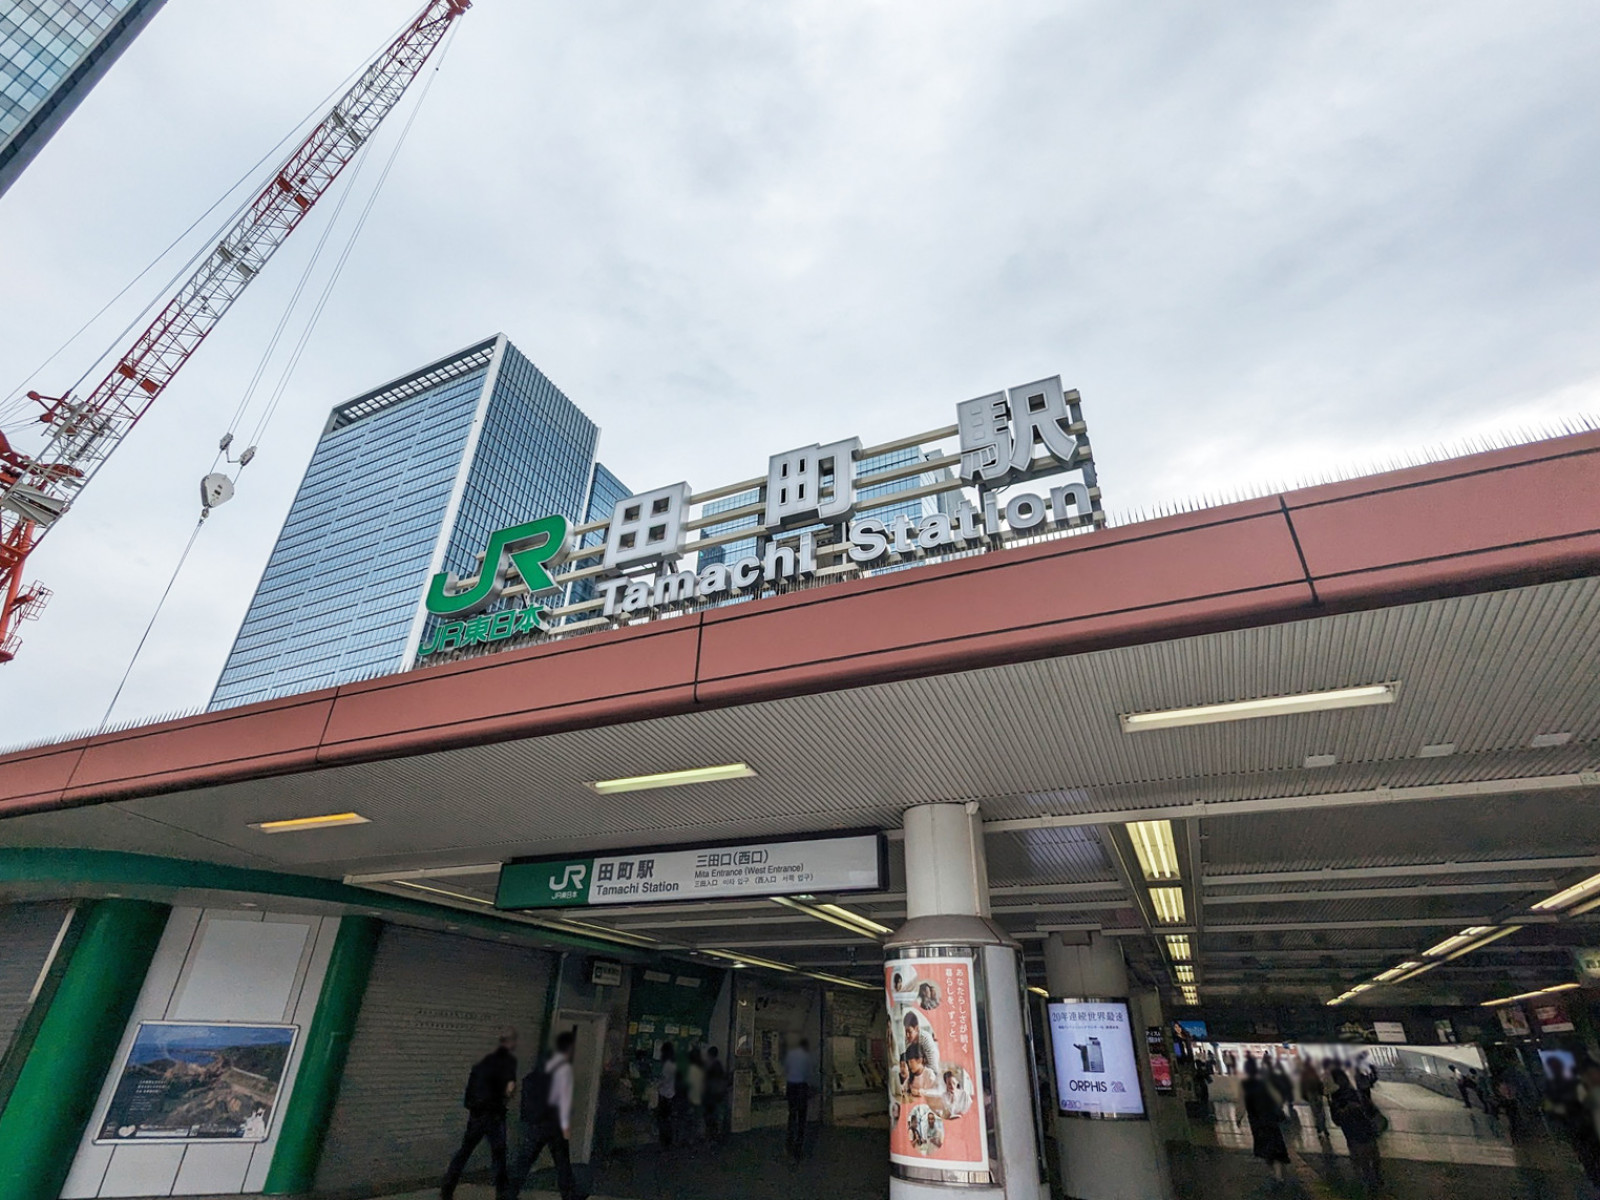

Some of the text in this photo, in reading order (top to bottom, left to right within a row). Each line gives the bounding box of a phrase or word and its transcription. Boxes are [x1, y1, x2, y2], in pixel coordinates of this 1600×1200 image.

[603, 374, 1077, 570] 田町駅
[597, 482, 1093, 616] Tamachi Station
[425, 513, 568, 615] JR
[417, 603, 545, 656] JR東日本
[597, 859, 655, 881] 田町駅
[696, 849, 769, 868] 三田口(西口)
[549, 864, 587, 891] JR
[694, 863, 804, 879] Mita Entrance (West Entrance)
[596, 881, 680, 896] Tamachi Station
[956, 968, 969, 1054] あなたらしさが続く
[1051, 1011, 1124, 1022] 20年連続世界最速
[1069, 1079, 1108, 1093] ORPHIS
